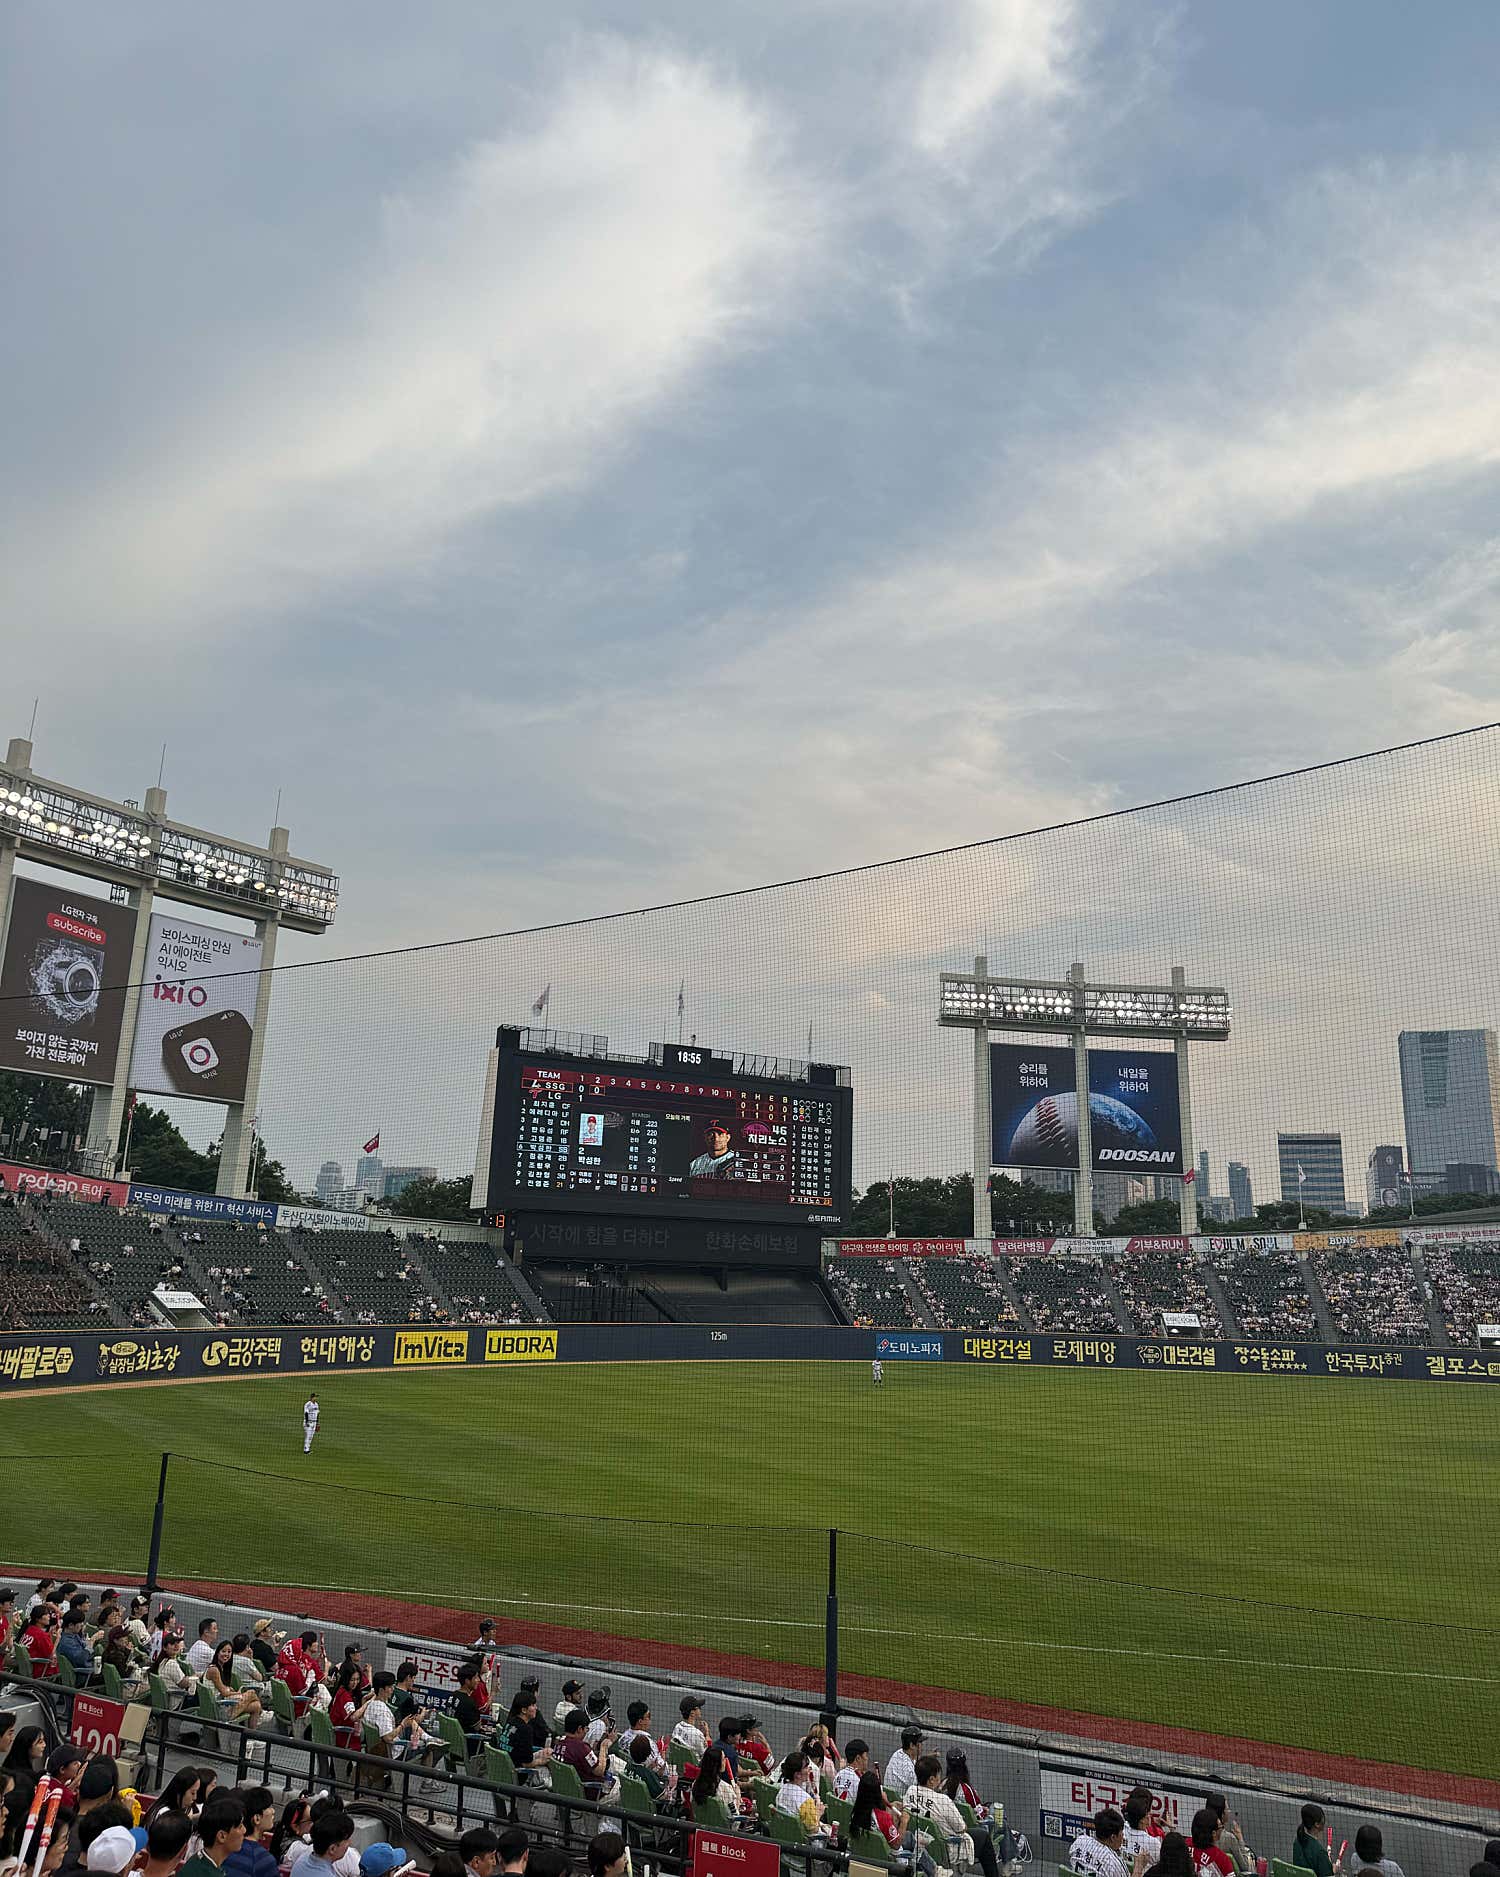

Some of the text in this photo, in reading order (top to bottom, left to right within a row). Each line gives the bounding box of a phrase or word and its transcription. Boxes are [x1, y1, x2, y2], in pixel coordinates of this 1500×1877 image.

[61, 904, 85, 919] LG전자
[53, 918, 102, 941] subscribe
[161, 928, 231, 954] 보이스피싱 안심
[159, 943, 212, 964] AI 에이전트
[157, 956, 187, 972] 익시오
[16, 1029, 98, 1055] 보이지 않는 곳까지
[25, 1045, 86, 1066] 가전 전문케어
[677, 1050, 702, 1064] 18:55
[537, 1070, 560, 1080] TEAM
[1018, 1062, 1049, 1075] 승리를
[1118, 1067, 1149, 1080] 내일을
[545, 1082, 566, 1091] SSG
[1019, 1075, 1049, 1089] 위하여
[1119, 1081, 1149, 1093] 위하여
[548, 1092, 562, 1100] LG
[772, 1125, 788, 1135] 46
[748, 1134, 787, 1146] 치리노스
[578, 1147, 585, 1155] 2
[1098, 1148, 1176, 1163] DOOSAN
[647, 1156, 656, 1164] 20
[775, 1173, 785, 1181] 73
[80, 1183, 103, 1199] 투어
[134, 1191, 273, 1220] 모두의 미래를 위한 IT 혁신 서비스
[281, 1208, 366, 1229] 두산디지털이노베이션
[1134, 1239, 1184, 1251] 기부&RUN
[710, 1331, 728, 1342] 125m
[228, 1337, 282, 1367] 금강주택
[300, 1335, 376, 1364] 현대해상
[488, 1336, 555, 1354] UBORA
[889, 1342, 941, 1355] 도미노피자
[963, 1338, 1033, 1361] 대방건설
[1053, 1340, 1117, 1364] 로제비앙
[109, 1340, 181, 1374] 실장님 회초장
[1163, 1345, 1216, 1366] 대보건설
[1325, 1351, 1403, 1374] 한국투자 증권
[1426, 1356, 1488, 1376] 겔포스
[73, 1726, 117, 1760] 120
[702, 1841, 746, 1859] 블록 Block
